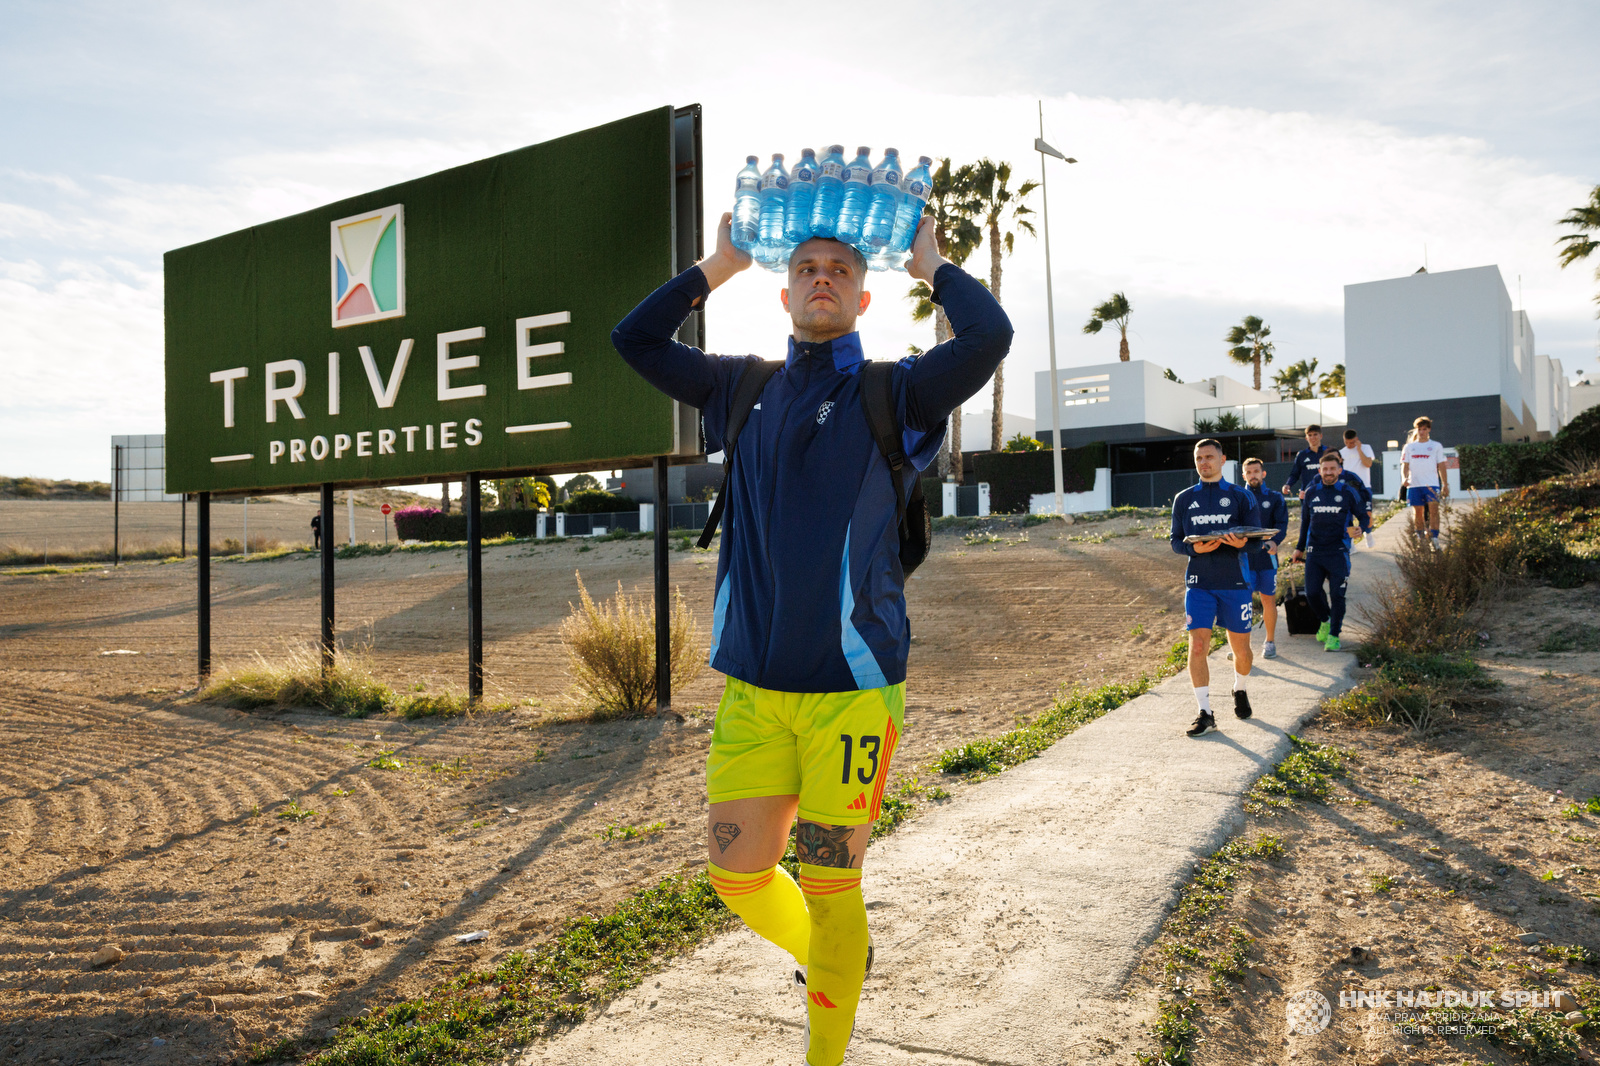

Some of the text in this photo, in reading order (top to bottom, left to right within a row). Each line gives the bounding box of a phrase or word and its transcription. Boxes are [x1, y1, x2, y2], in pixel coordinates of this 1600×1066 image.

[210, 311, 573, 428] TRIVEE
[269, 418, 484, 464] PROPERTIES
[1191, 514, 1231, 525] TOMMY
[840, 734, 881, 785] 13
